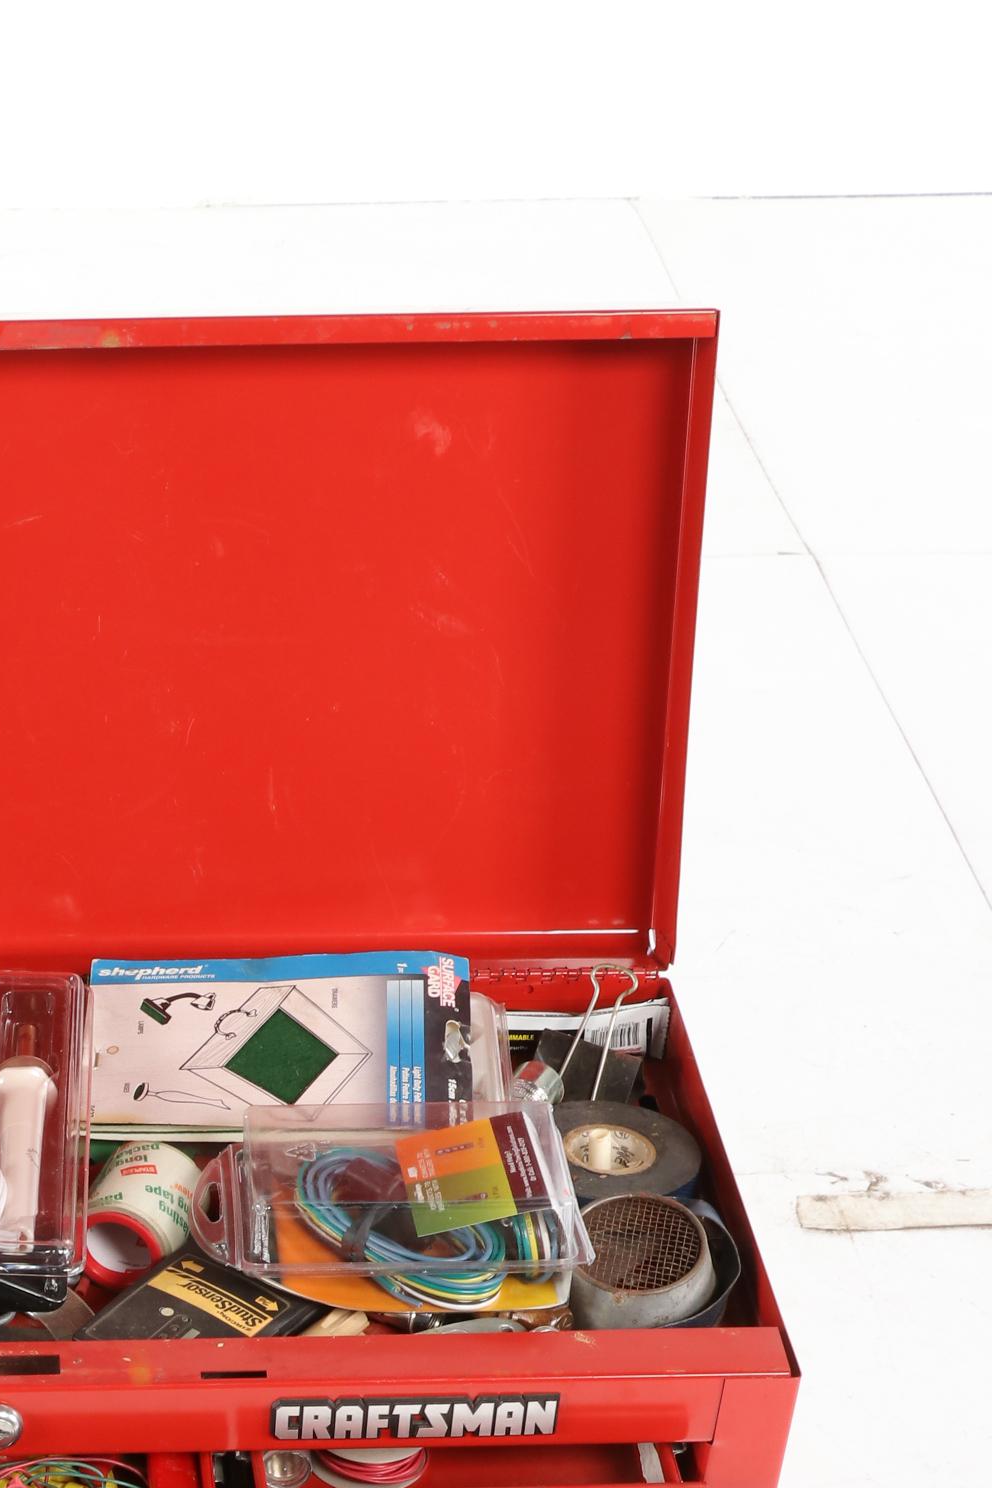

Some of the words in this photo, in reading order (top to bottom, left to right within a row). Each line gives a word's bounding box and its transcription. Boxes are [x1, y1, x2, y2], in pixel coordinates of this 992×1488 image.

[98, 965, 203, 980] shepherd
[427, 965, 440, 998] GARD
[442, 957, 456, 1007] SURFACE
[448, 1078, 457, 1099] 15cm
[115, 1143, 160, 1158] packa
[145, 1185, 173, 1206] tape
[179, 1282, 262, 1328] StudSensor
[272, 1398, 559, 1440] CRAFTSMAN
